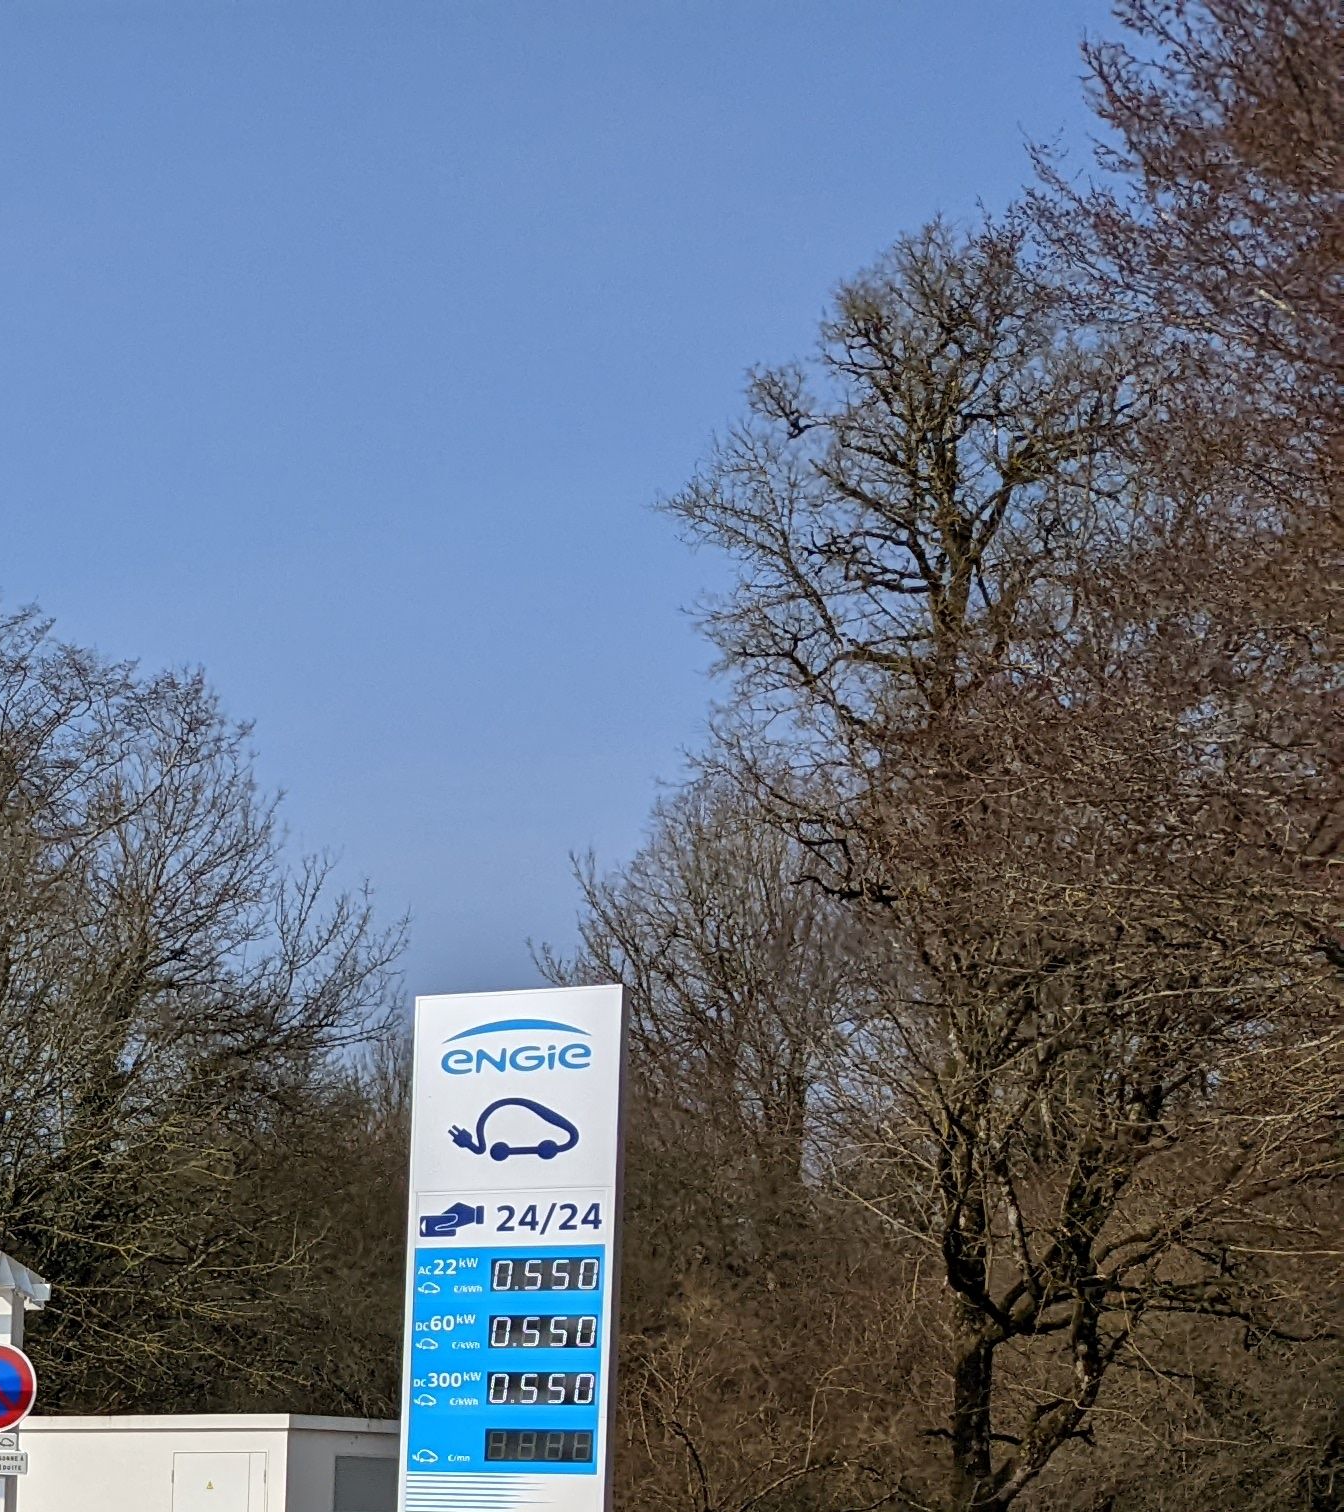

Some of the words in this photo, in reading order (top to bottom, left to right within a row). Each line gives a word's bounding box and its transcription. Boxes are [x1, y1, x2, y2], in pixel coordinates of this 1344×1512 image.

[496, 1202, 603, 1236] 24/24
[493, 1259, 599, 1290] 0.550
[490, 1316, 597, 1347] 0.550
[489, 1373, 595, 1404] 0.550
